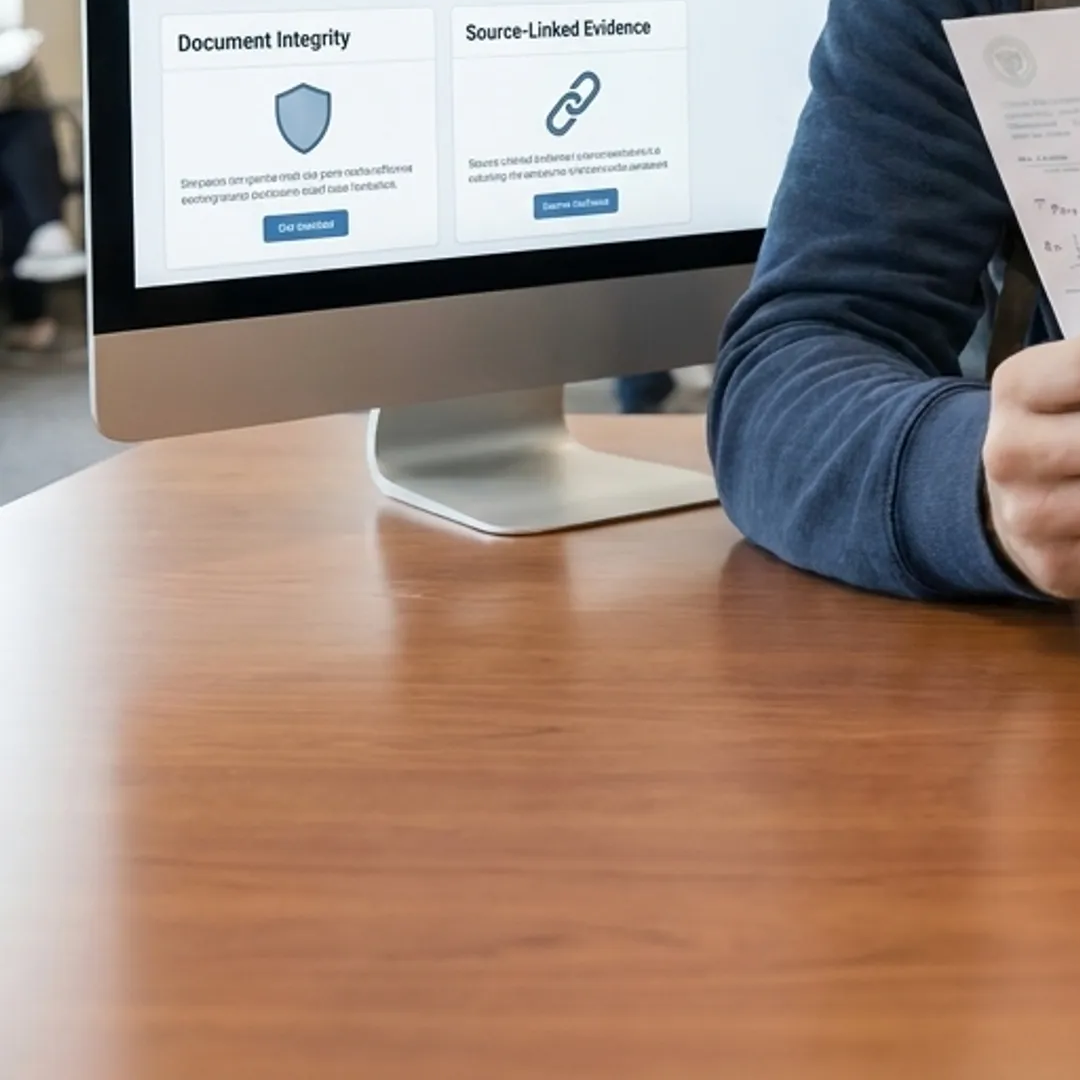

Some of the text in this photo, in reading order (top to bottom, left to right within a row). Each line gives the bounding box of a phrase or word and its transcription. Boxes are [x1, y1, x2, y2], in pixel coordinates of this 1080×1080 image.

[178, 28, 351, 53] Document Integrity
[465, 18, 652, 41] Source-Linked Evidence
